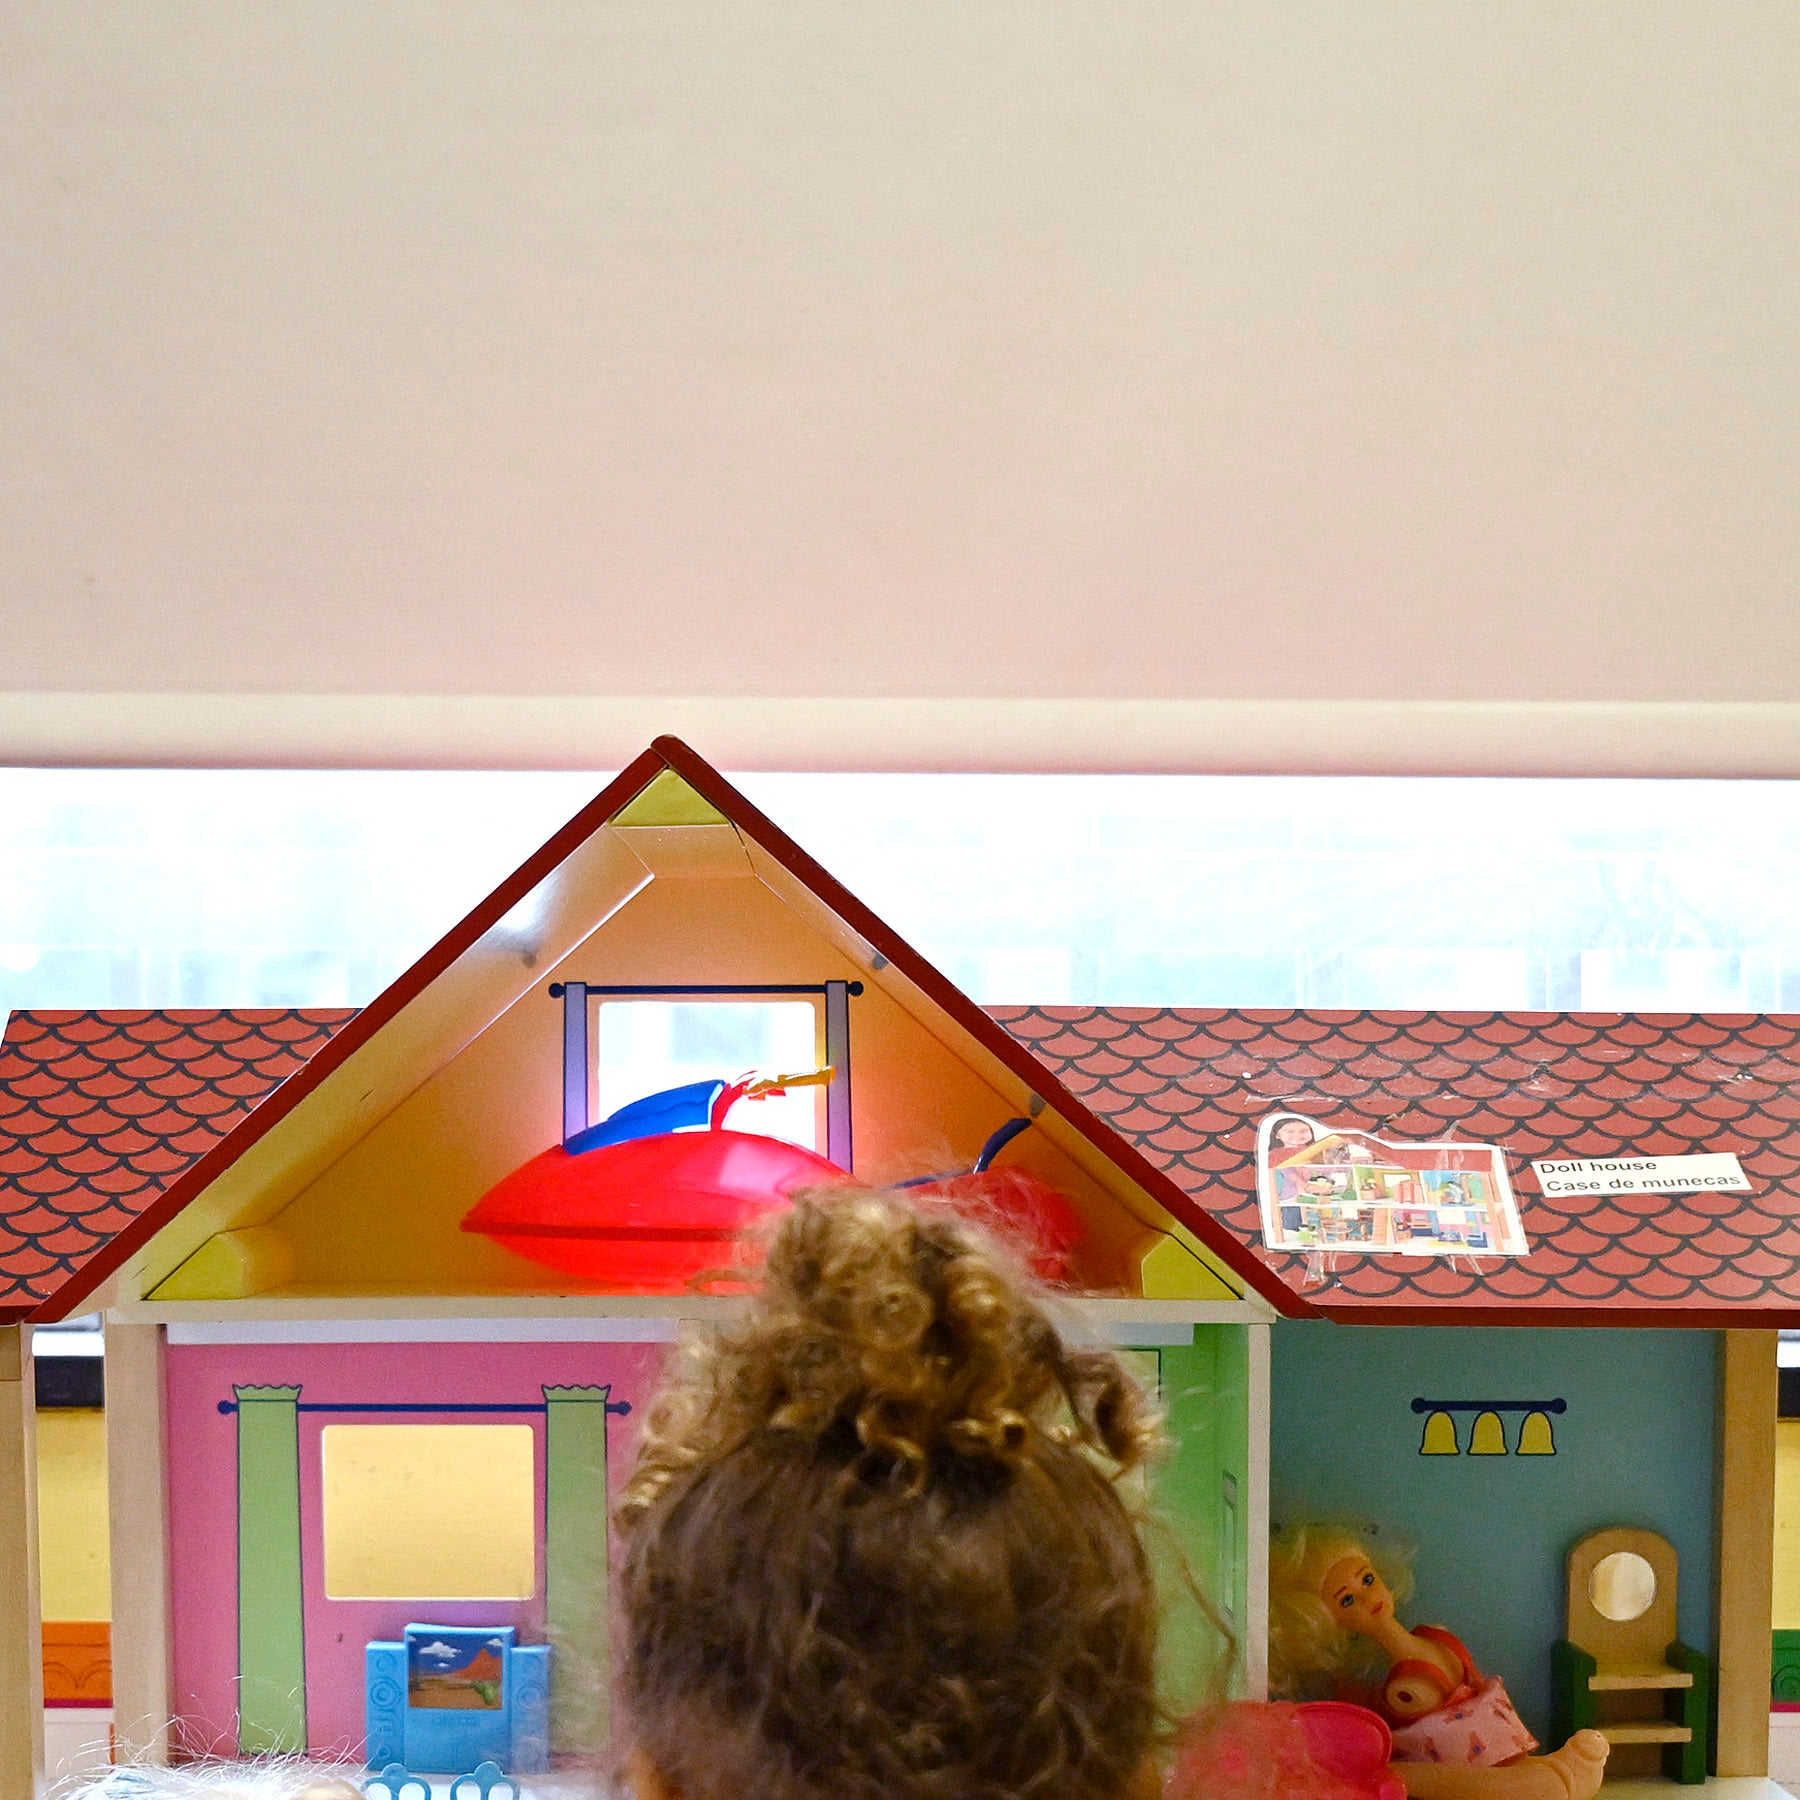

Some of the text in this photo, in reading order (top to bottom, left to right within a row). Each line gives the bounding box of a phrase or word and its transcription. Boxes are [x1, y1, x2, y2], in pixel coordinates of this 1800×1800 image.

[1540, 1161, 1657, 1174] Doll house
[1547, 1176, 1741, 1191] Case de munecas
